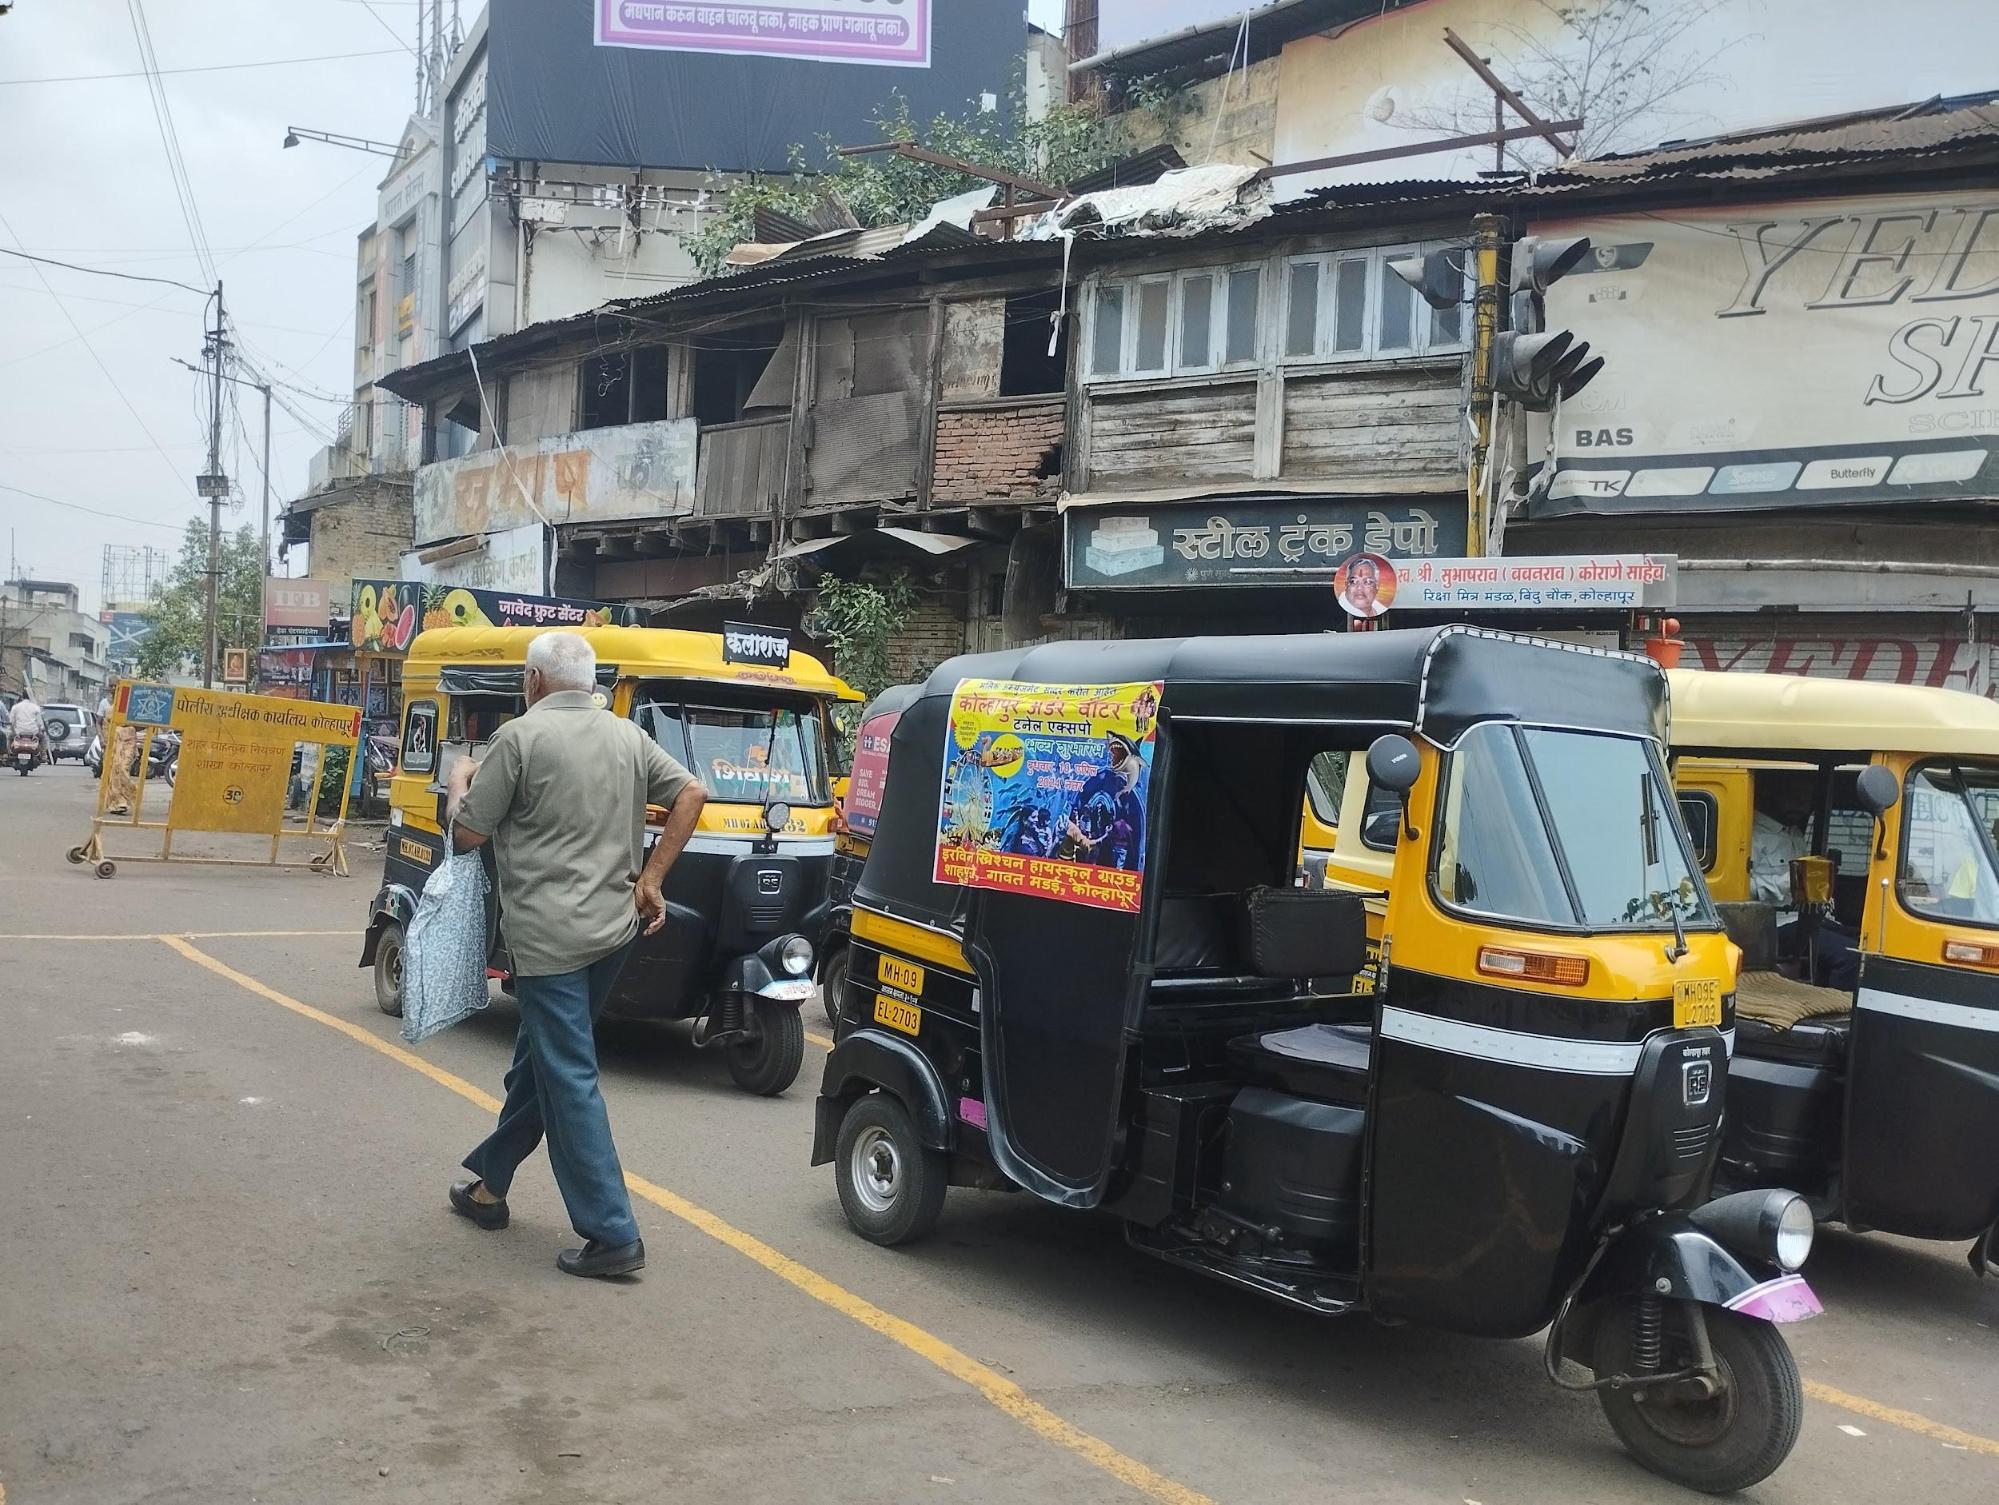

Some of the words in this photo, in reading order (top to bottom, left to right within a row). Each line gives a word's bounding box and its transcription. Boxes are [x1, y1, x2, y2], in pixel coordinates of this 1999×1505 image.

[624, 3, 664, 22] मद्यपान
[697, 8, 725, 26] वाहन
[788, 13, 820, 31] नाहक
[821, 14, 843, 33] प्राण
[1576, 428, 1634, 447] BAS
[1830, 467, 1876, 480] Butterfly
[1172, 516, 1270, 560] स्टील
[1277, 514, 1354, 563] ट्रंक
[1363, 508, 1439, 556] डेपो
[273, 590, 321, 608] IFB
[1424, 588, 1451, 602] रिक्षा
[1458, 588, 1479, 601] मित्र
[1579, 587, 1636, 605] कोल्हापूर
[498, 598, 532, 617] जावेद
[557, 603, 585, 622] सेंटर
[310, 712, 353, 738] कोल्हापूर
[1013, 716, 1043, 732] टनेल
[1047, 719, 1092, 735] एक्सपो
[873, 736, 891, 753] ES
[1024, 738, 1054, 754] भव्य
